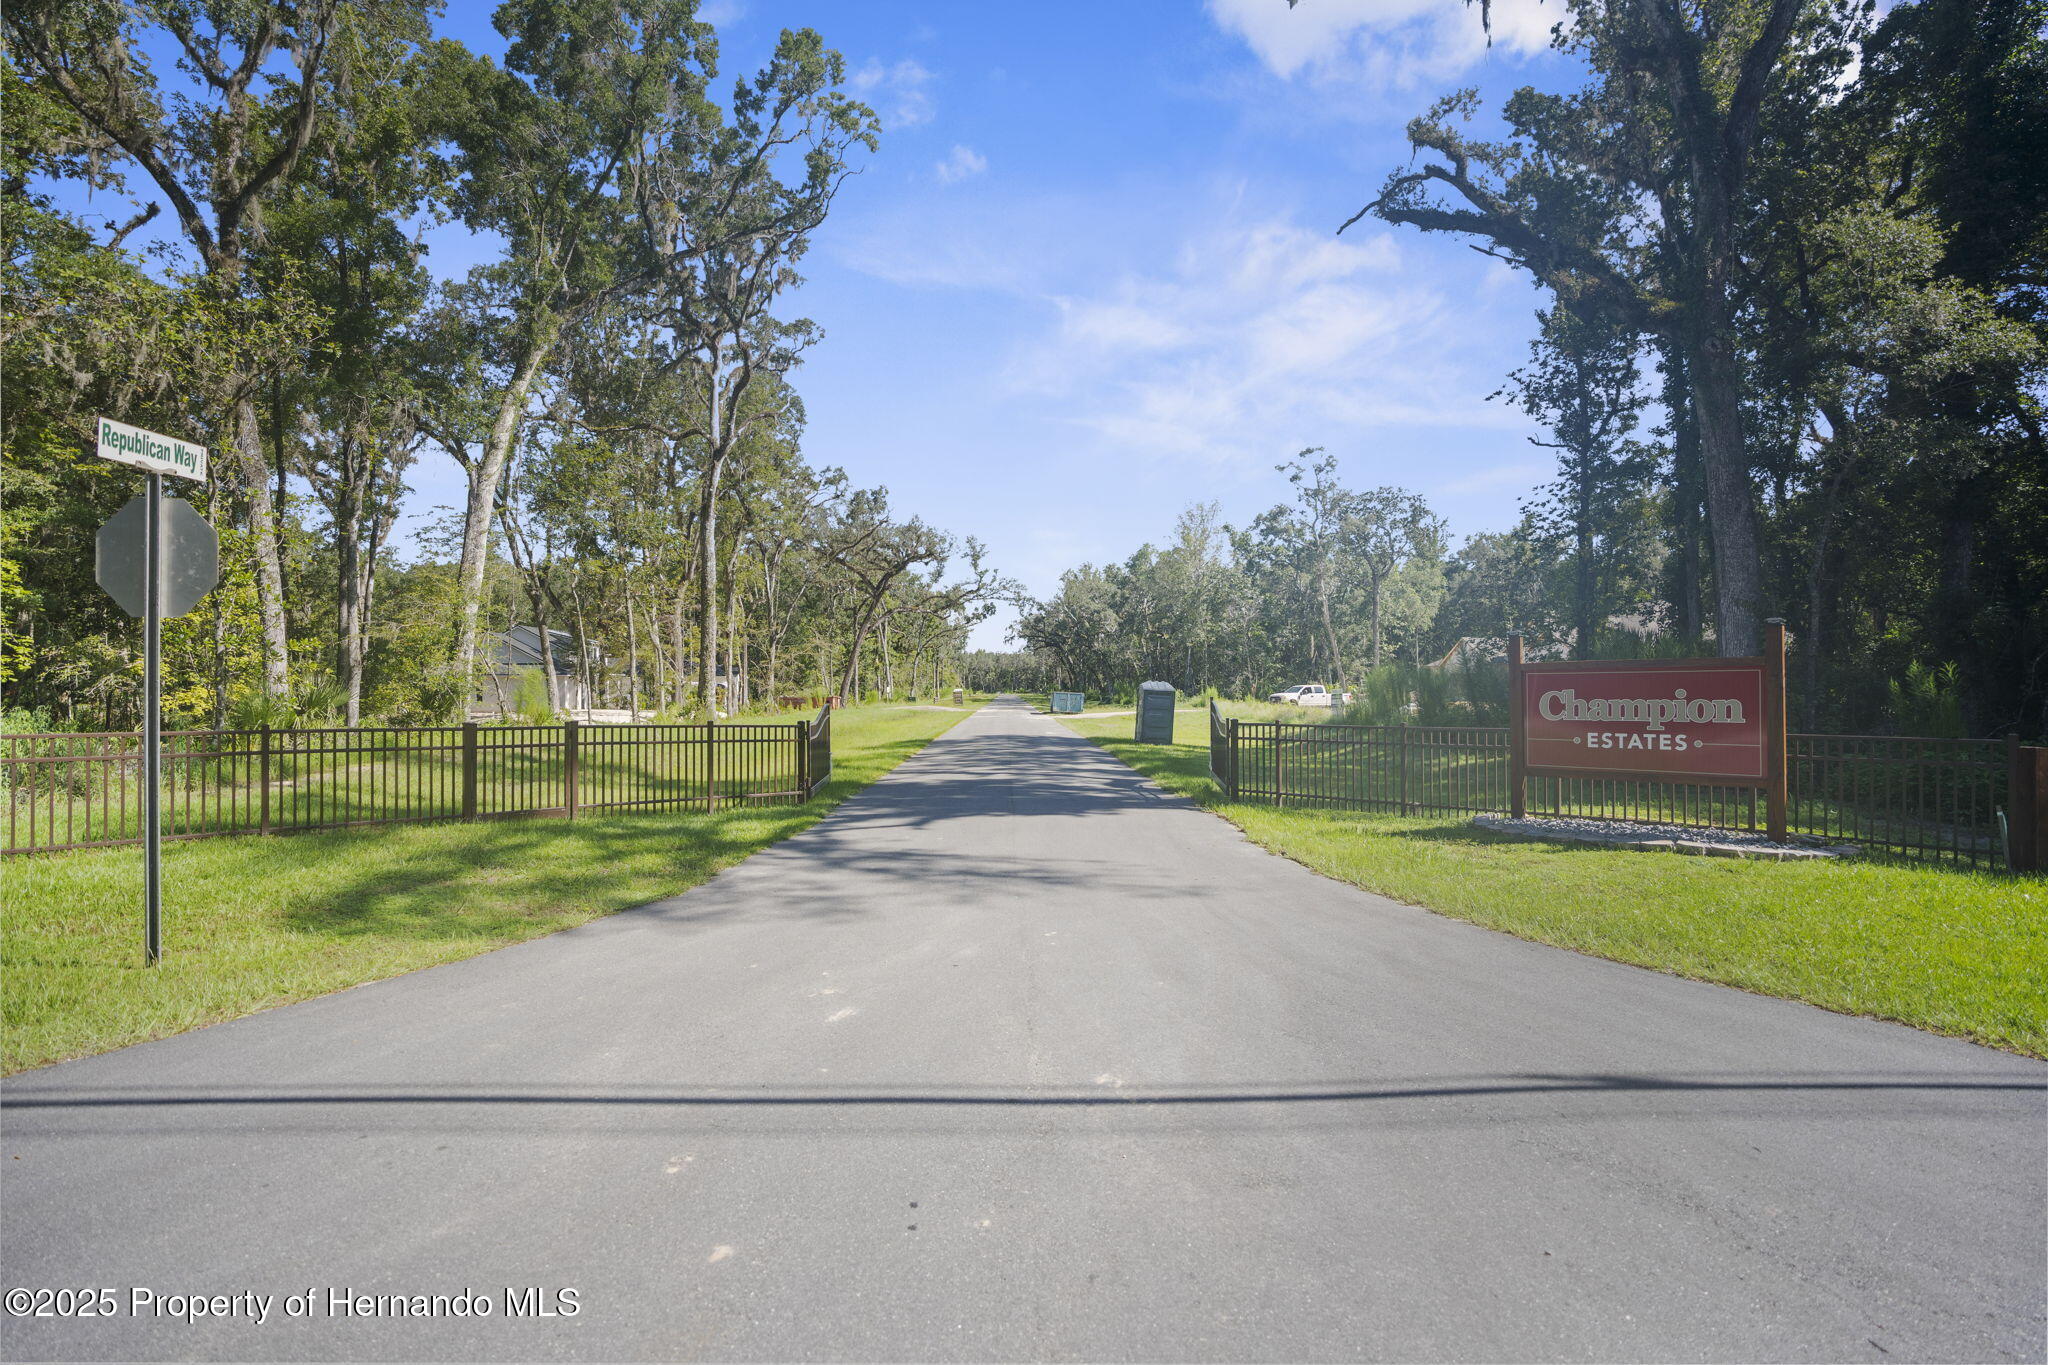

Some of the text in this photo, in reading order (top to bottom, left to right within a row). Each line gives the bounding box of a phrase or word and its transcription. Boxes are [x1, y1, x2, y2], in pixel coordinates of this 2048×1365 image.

[102, 423, 198, 473] Republican Way
[1538, 689, 1746, 730] Champion
[1587, 732, 1688, 751] ESTATES
